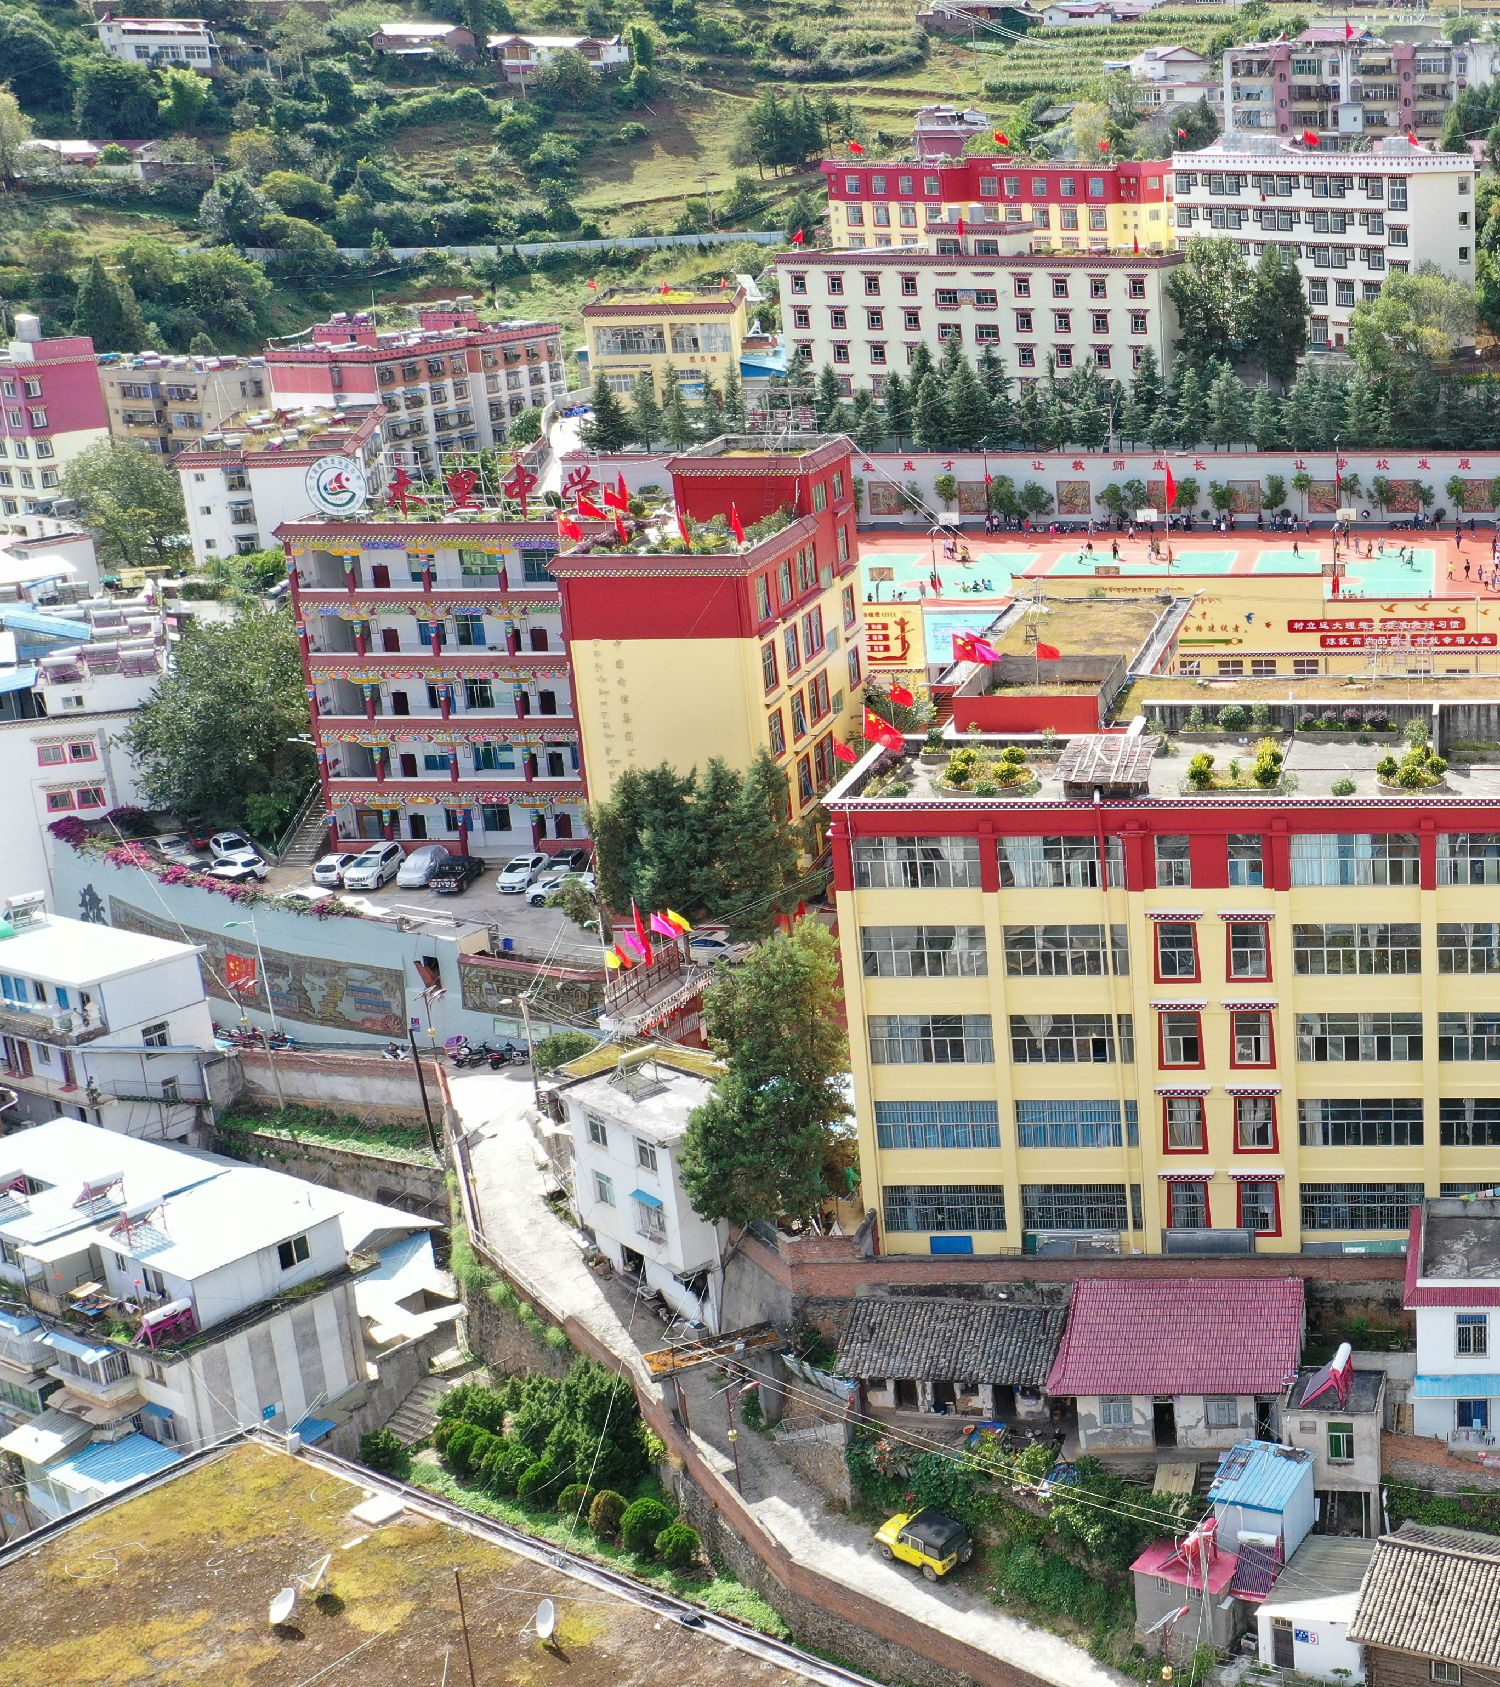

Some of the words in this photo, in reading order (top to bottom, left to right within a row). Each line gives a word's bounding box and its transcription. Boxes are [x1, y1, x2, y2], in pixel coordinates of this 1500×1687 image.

[862, 461, 955, 472] 生成才
[1032, 460, 1207, 471] 让教师成长
[1294, 459, 1471, 470] 让学校发展
[386, 463, 601, 519] 木里中学
[1310, 1633, 1316, 1643] 5
